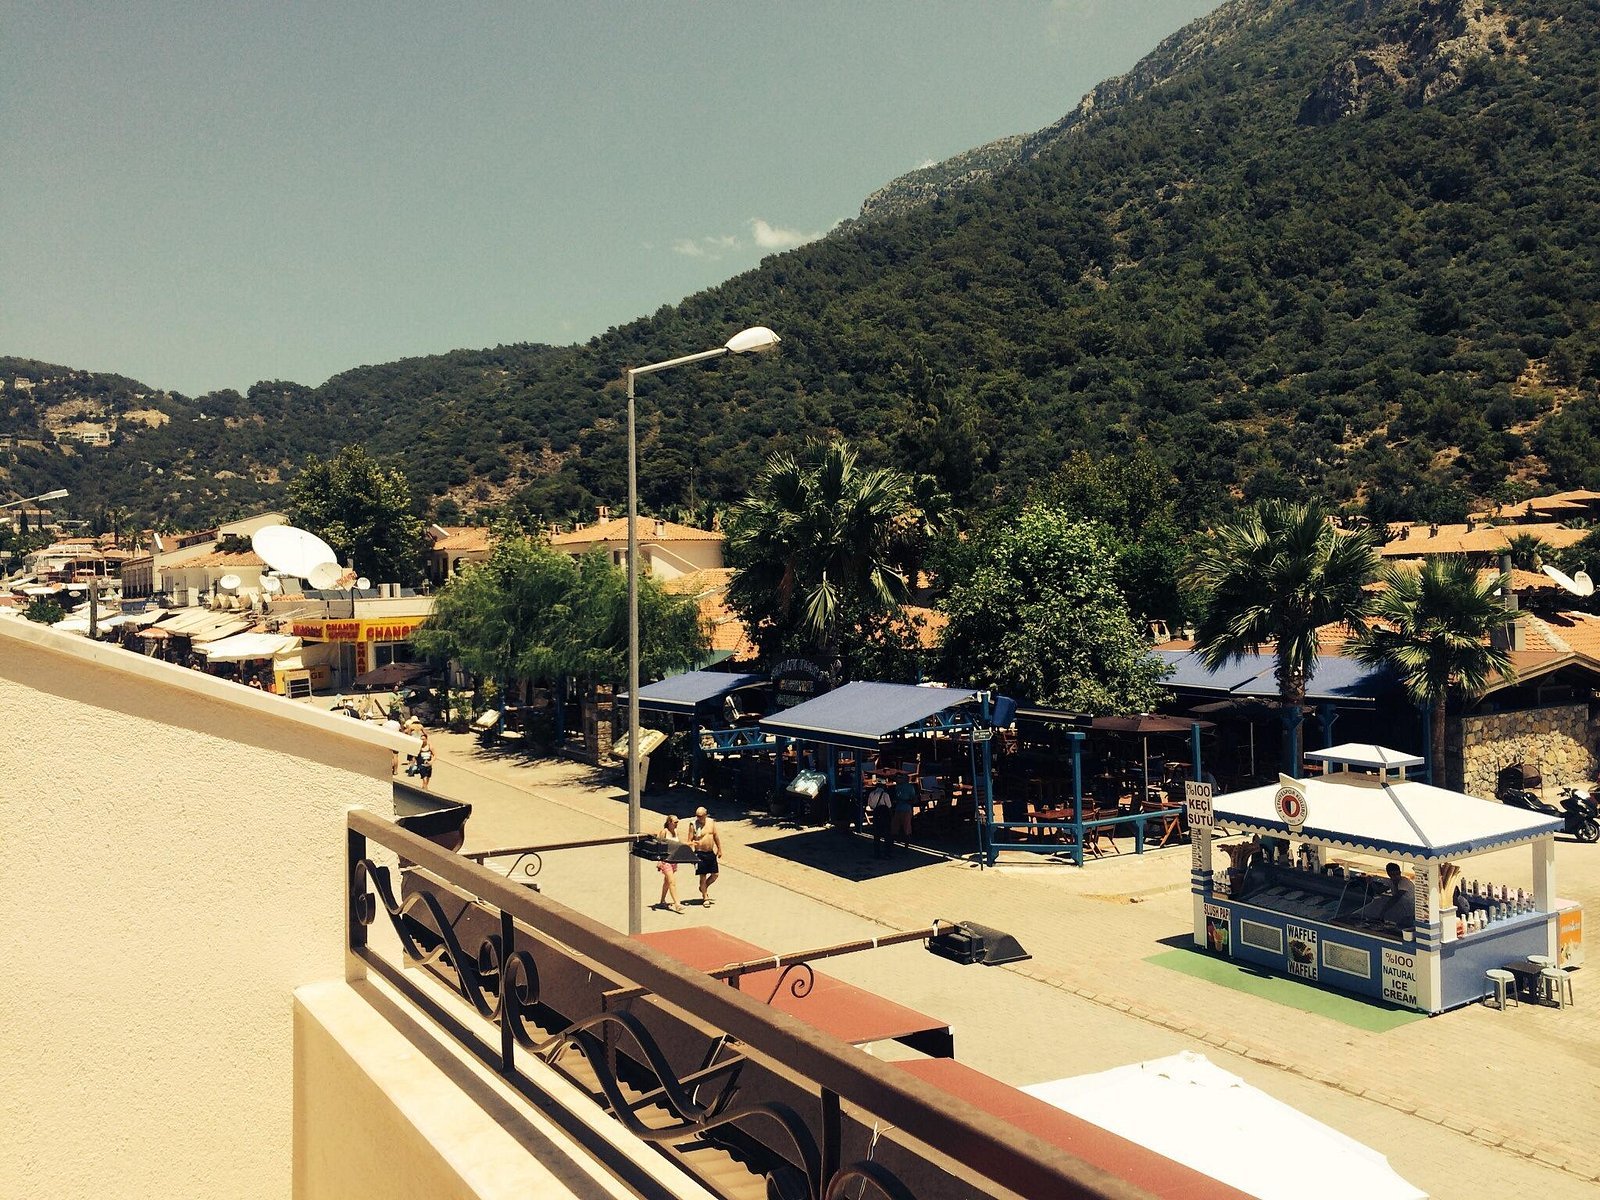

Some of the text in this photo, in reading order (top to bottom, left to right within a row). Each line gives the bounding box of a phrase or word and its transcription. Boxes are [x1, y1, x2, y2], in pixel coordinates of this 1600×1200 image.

[1186, 784, 1211, 797] %100
[1189, 798, 1211, 813] KEÇİ
[1287, 925, 1316, 944] WAFFLE
[1385, 952, 1414, 968] %100
[1288, 960, 1317, 980] WAFFLE
[1383, 965, 1416, 982] NATURAL
[1392, 979, 1408, 991] ICE
[1383, 988, 1417, 1005] CREAM
